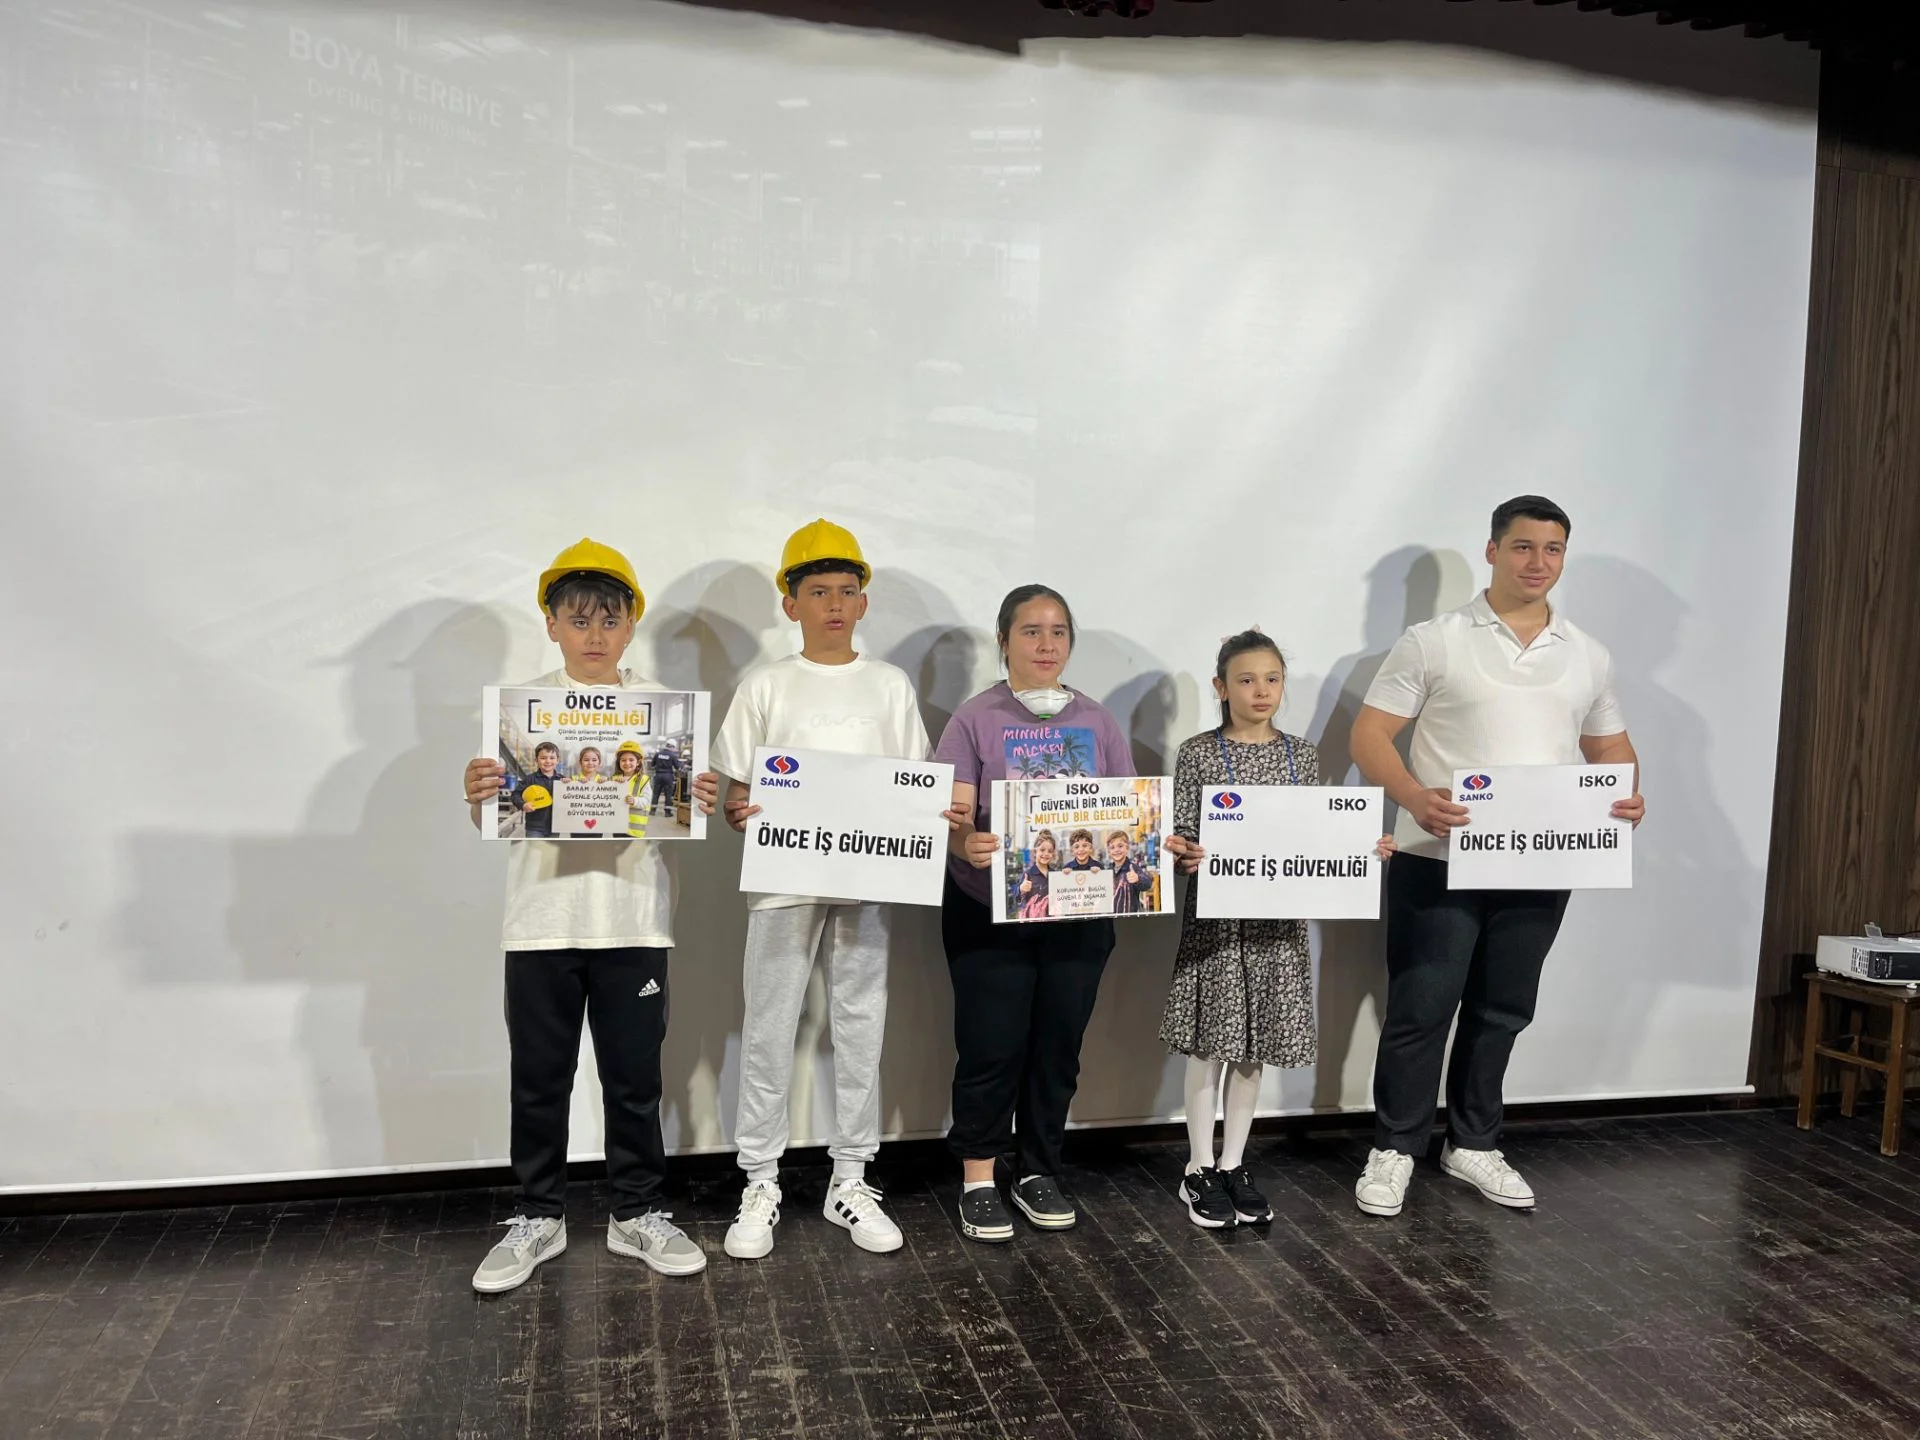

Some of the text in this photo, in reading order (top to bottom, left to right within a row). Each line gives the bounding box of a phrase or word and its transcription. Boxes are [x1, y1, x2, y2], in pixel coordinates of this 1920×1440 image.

[289, 25, 383, 86] BOYA
[565, 691, 616, 710] ÖNCE
[536, 709, 645, 729] İŞ GÜVENLİĞİ
[1003, 726, 1062, 741] MINNIE &
[760, 777, 800, 789] SANKO
[894, 771, 936, 788] ISKO
[1579, 775, 1617, 788] ISKO
[1066, 783, 1099, 795] ISKO
[1459, 792, 1494, 802] SANKO
[1041, 796, 1129, 811] GÜVENLİ BİR YARIN,
[1328, 798, 1367, 811] ISKO
[1035, 808, 1134, 825] MUTLU BİR GELECEK
[1208, 812, 1244, 821] SANKO
[757, 822, 934, 860] ÖNCE İŞ GÜVENLİĞİ
[1460, 828, 1618, 855] ÖNCE İŞ GÜVENLİĞİ
[1209, 854, 1368, 881] ÖNCE İŞ GÜVENLİĞİ
